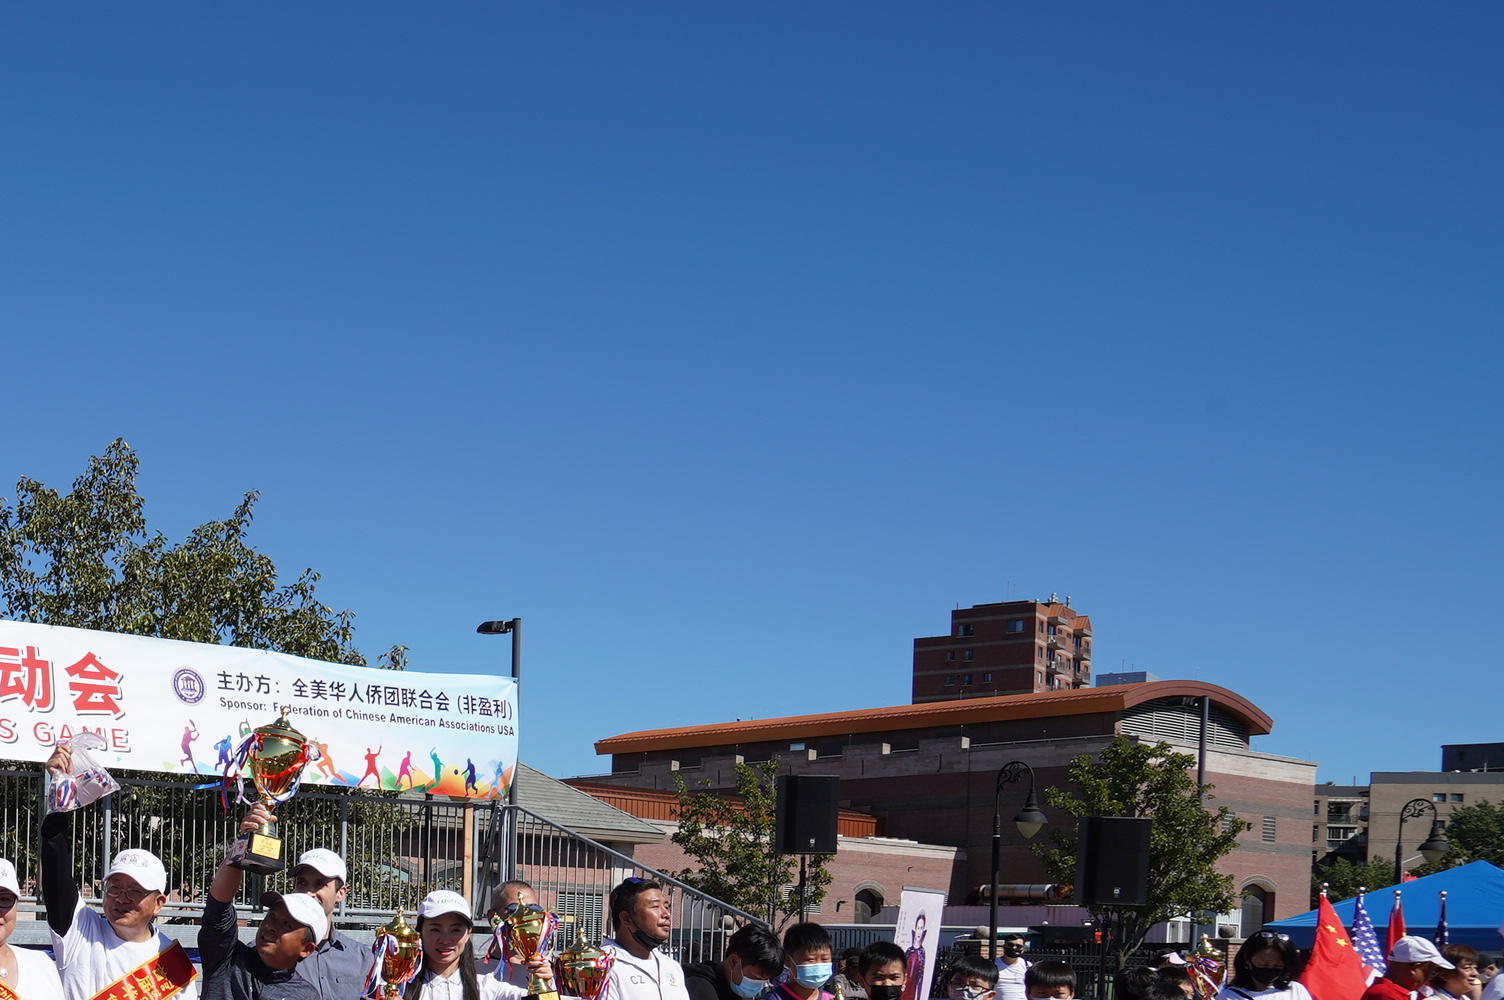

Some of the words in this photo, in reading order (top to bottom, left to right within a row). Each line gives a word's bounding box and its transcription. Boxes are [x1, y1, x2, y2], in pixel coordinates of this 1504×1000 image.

[220, 697, 267, 711] Sponsor:
[332, 707, 343, 719] of
[345, 708, 387, 723] Chinese
[389, 713, 436, 728] American
[439, 718, 496, 734] Associations
[497, 725, 515, 737] USA
[33, 721, 132, 753] GAME
[630, 975, 646, 985] CZ
